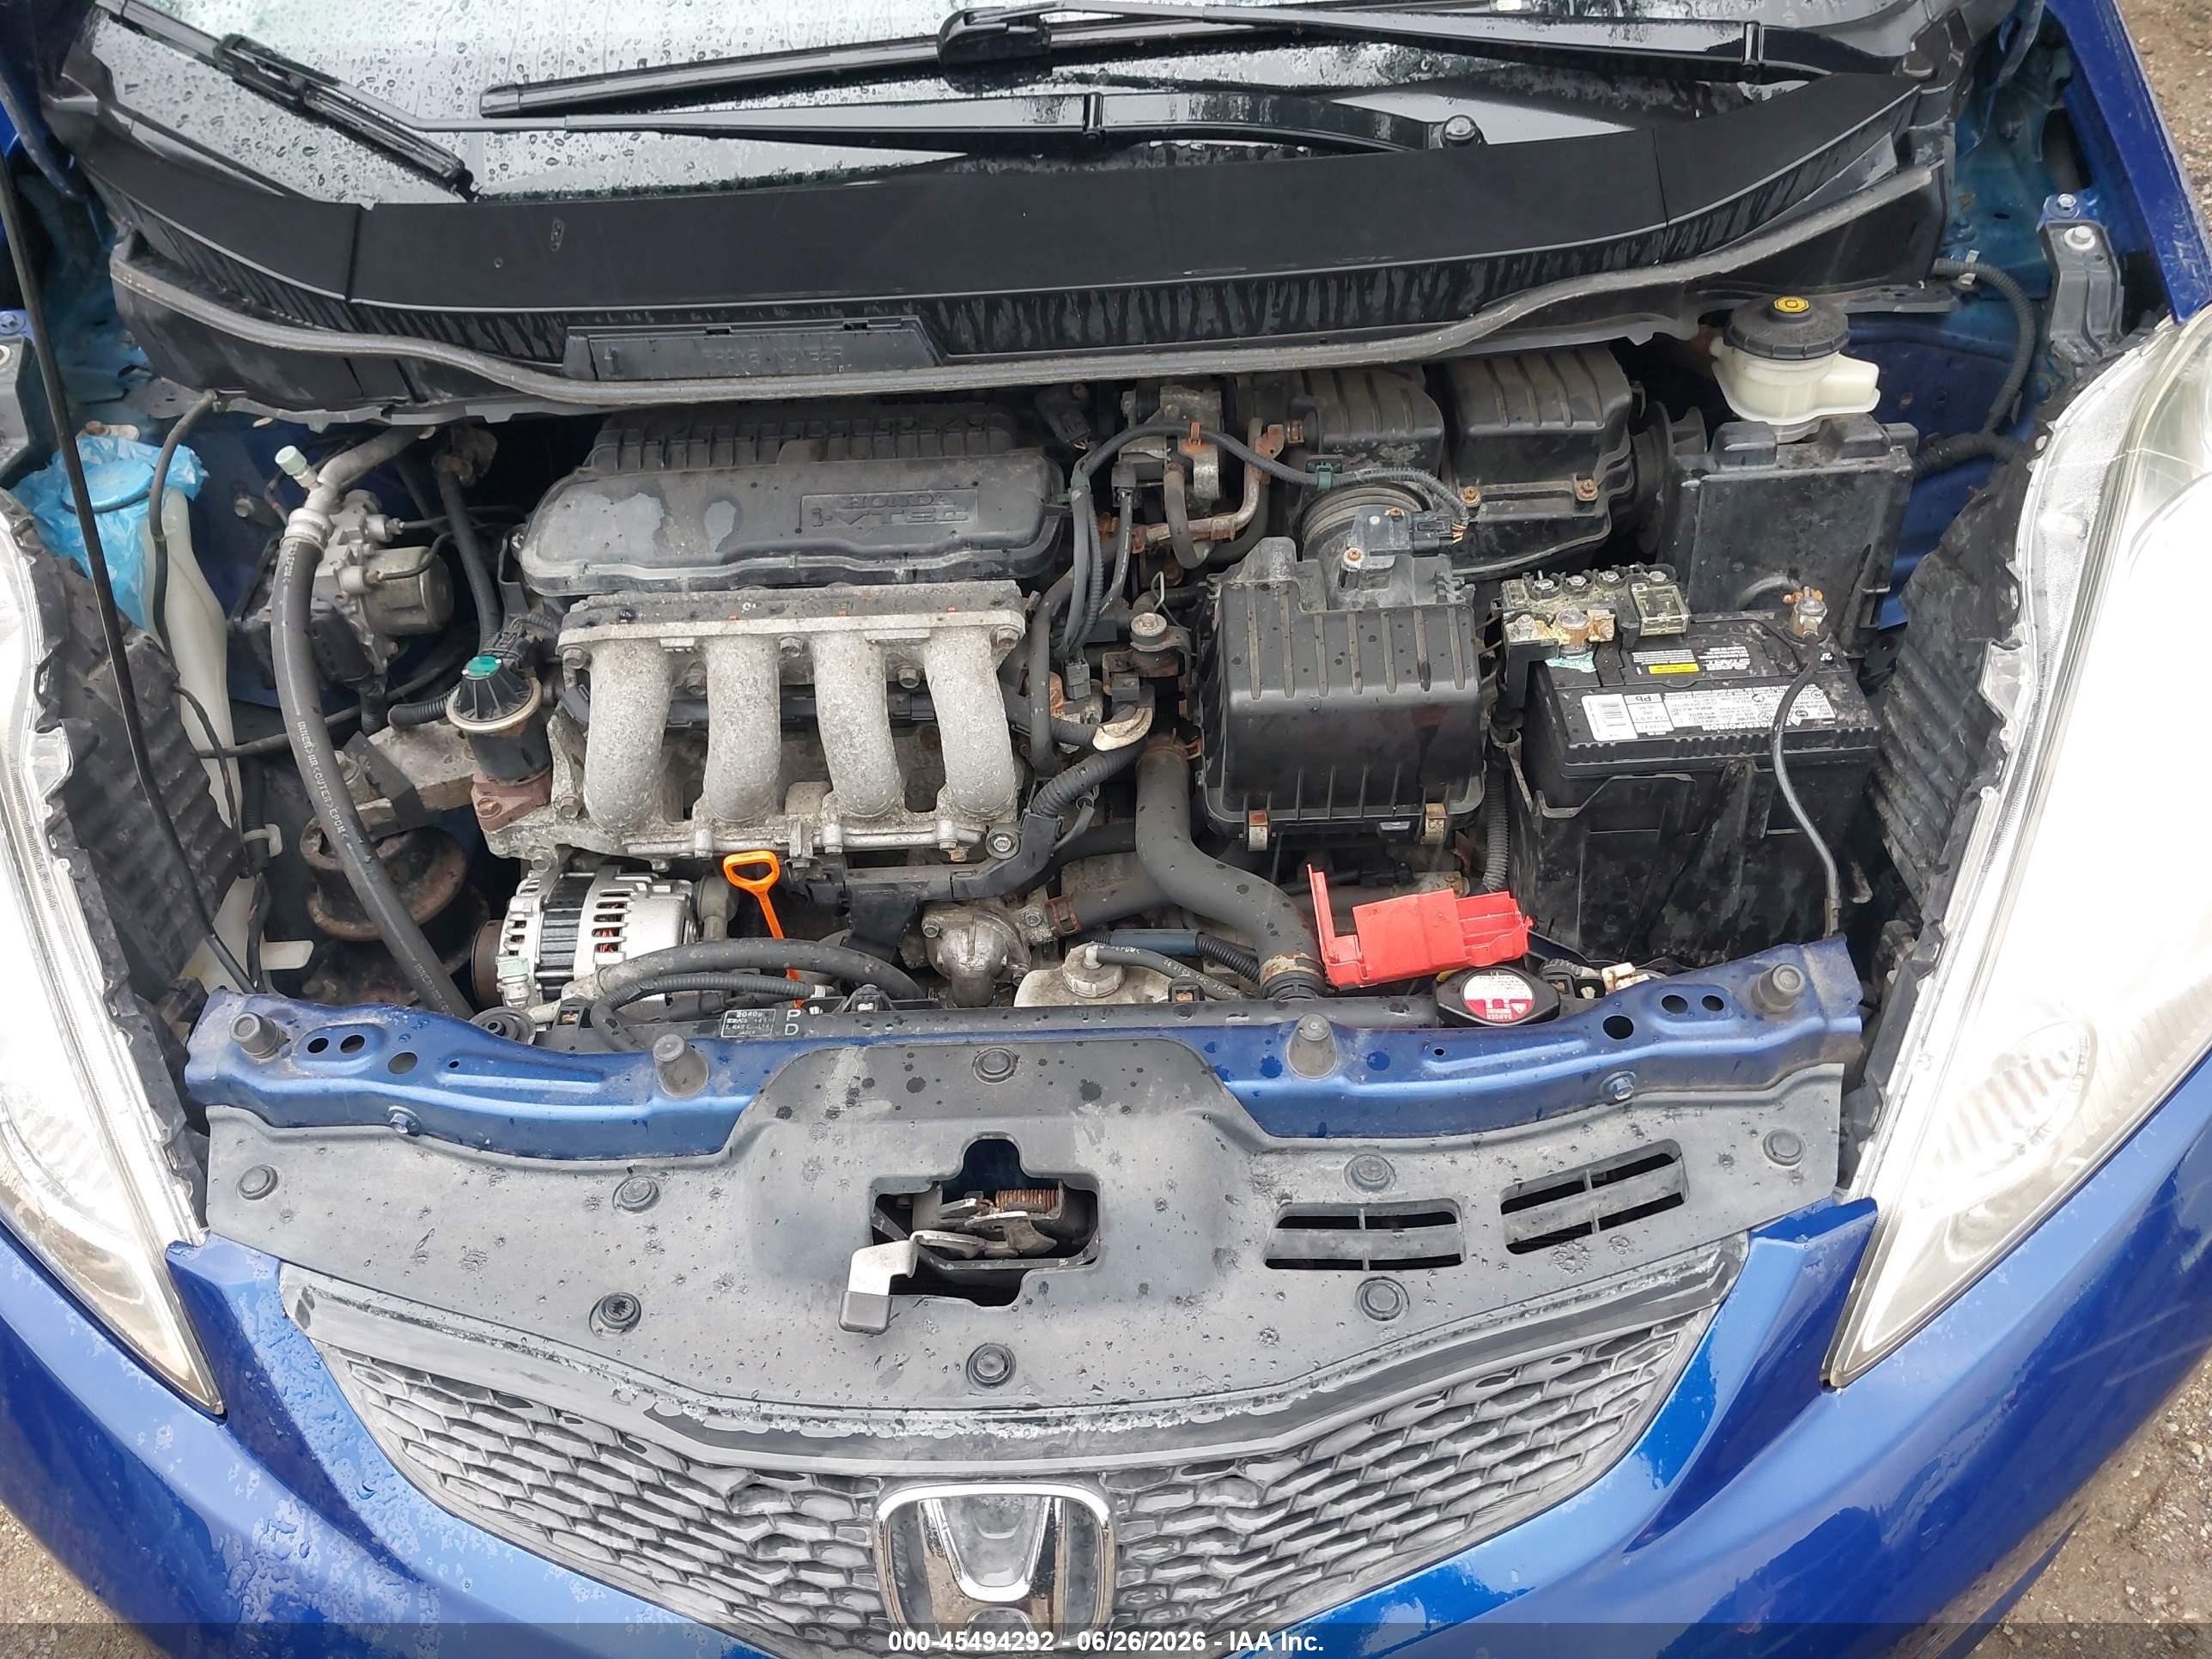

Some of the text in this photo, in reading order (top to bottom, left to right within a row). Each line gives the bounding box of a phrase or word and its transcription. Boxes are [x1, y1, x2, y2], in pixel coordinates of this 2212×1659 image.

[773, 345, 842, 363] NUMBER
[840, 492, 956, 509] HONDA
[787, 1009, 801, 1022] P
[784, 1023, 799, 1036] D
